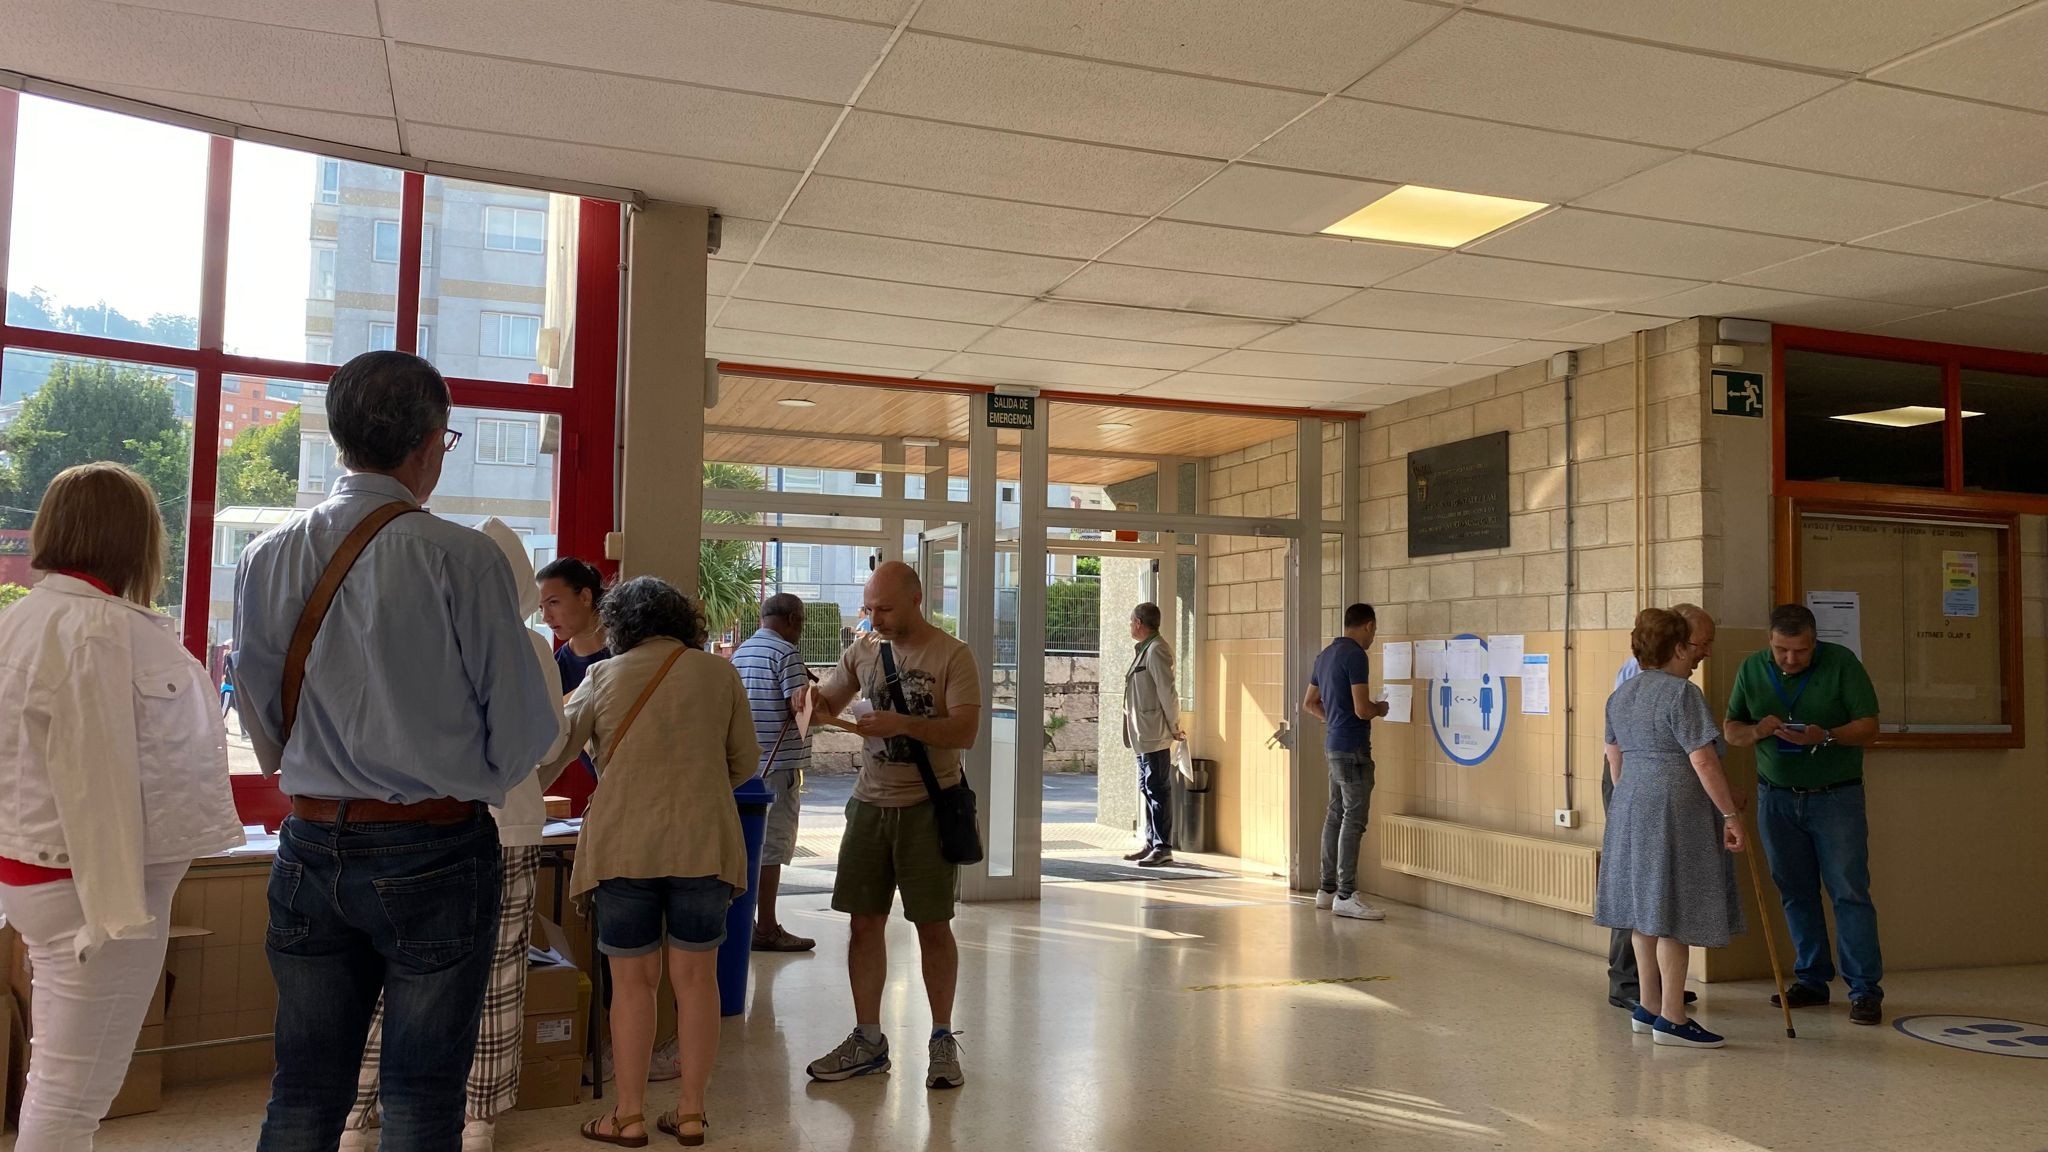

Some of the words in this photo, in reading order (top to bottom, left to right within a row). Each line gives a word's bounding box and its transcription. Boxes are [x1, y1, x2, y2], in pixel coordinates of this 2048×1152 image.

[994, 397, 1017, 408] SALIDA
[1019, 399, 1028, 409] DE
[989, 412, 1032, 425] EMERGENCIA
